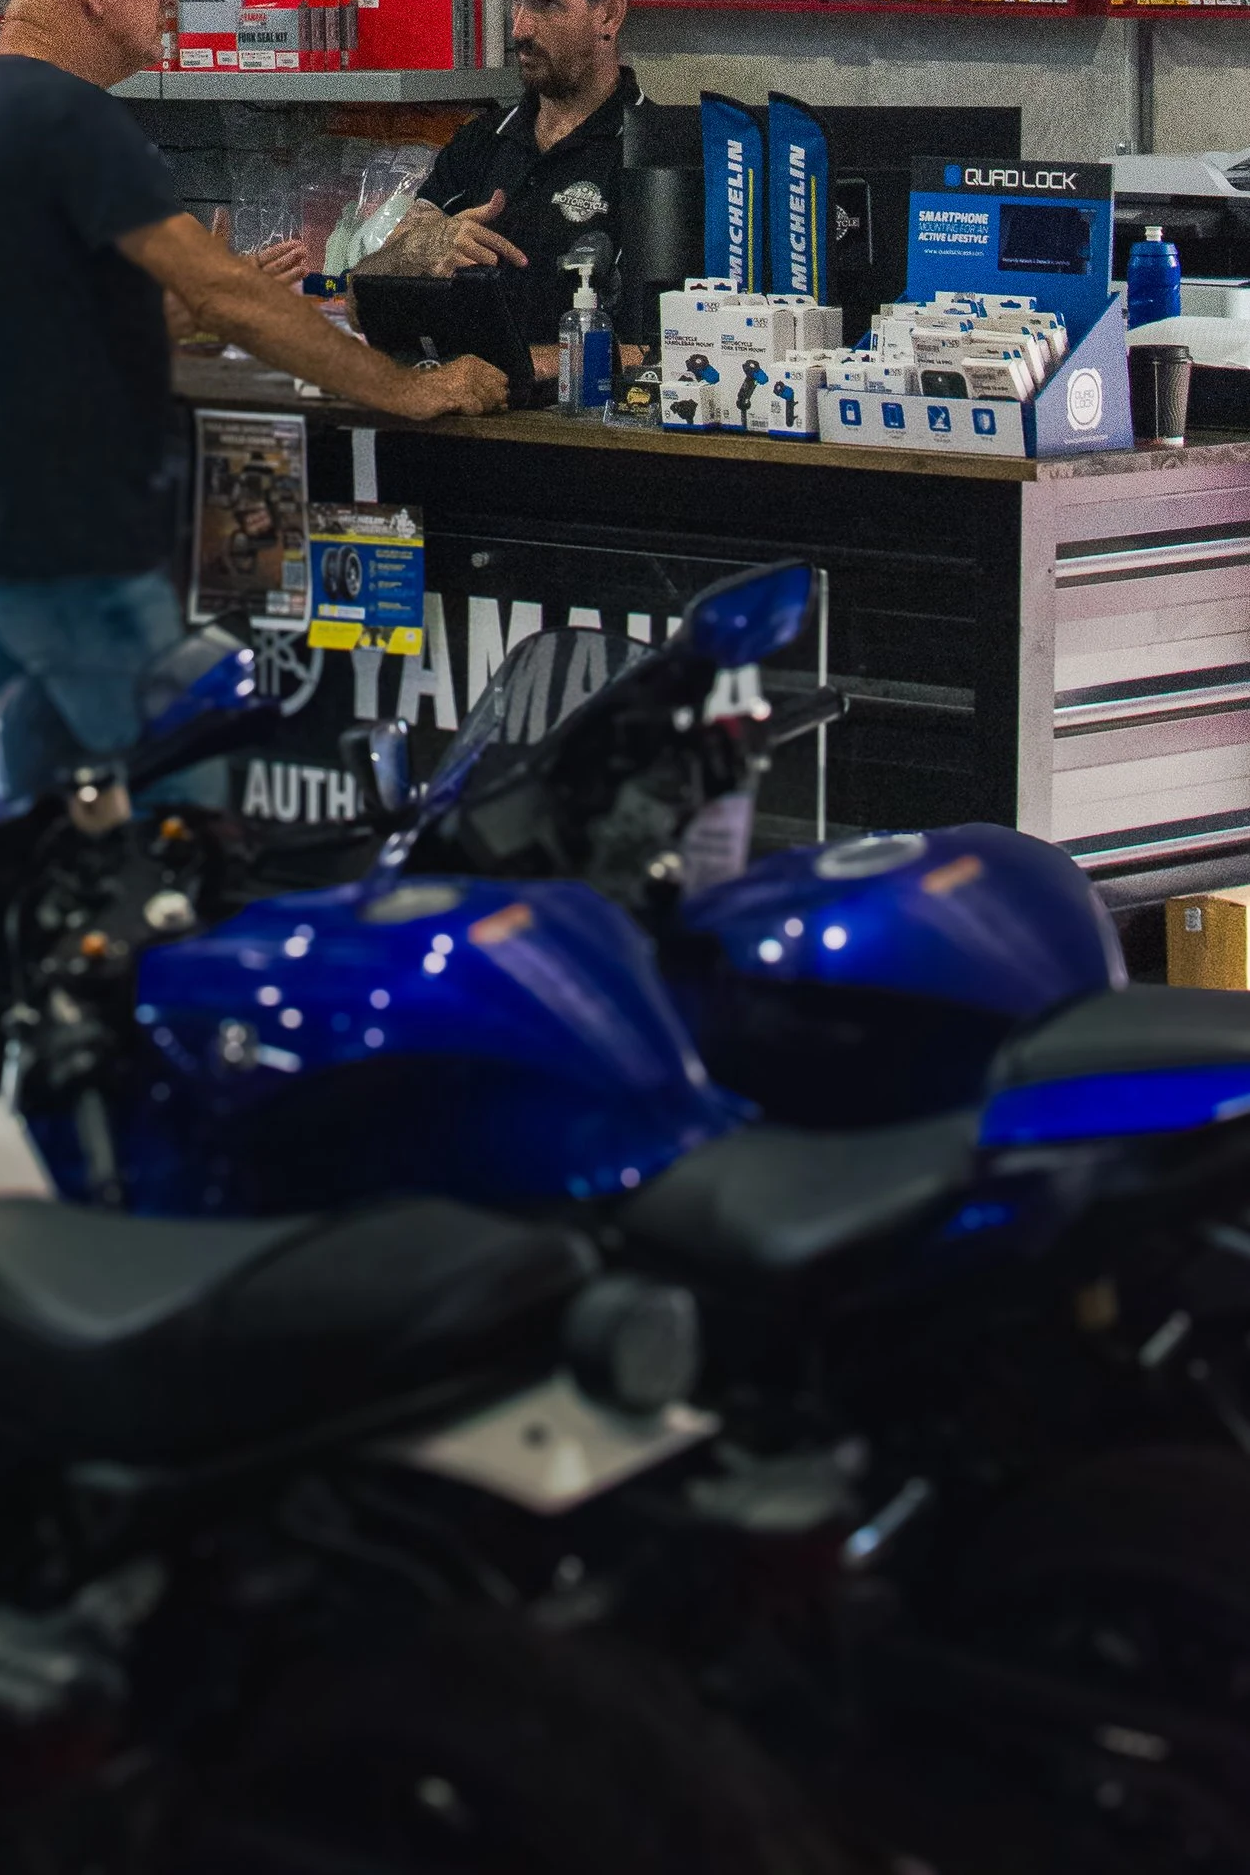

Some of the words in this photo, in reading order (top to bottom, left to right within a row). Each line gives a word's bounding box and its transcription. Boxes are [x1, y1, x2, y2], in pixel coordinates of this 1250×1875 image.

[238, 32, 256, 43] FORK
[256, 32, 275, 43] SEAL
[275, 32, 288, 43] KIT
[964, 168, 1020, 188] QUAD
[1022, 170, 1078, 190] LOCK
[551, 194, 609, 212] MOTORCYCLE
[727, 138, 745, 285] MICHELIN
[790, 143, 807, 292] MICHELIN
[918, 210, 990, 224] SMARTPHONE
[917, 232, 947, 242] ACTIVE
[947, 233, 990, 245] LIFESTYLE
